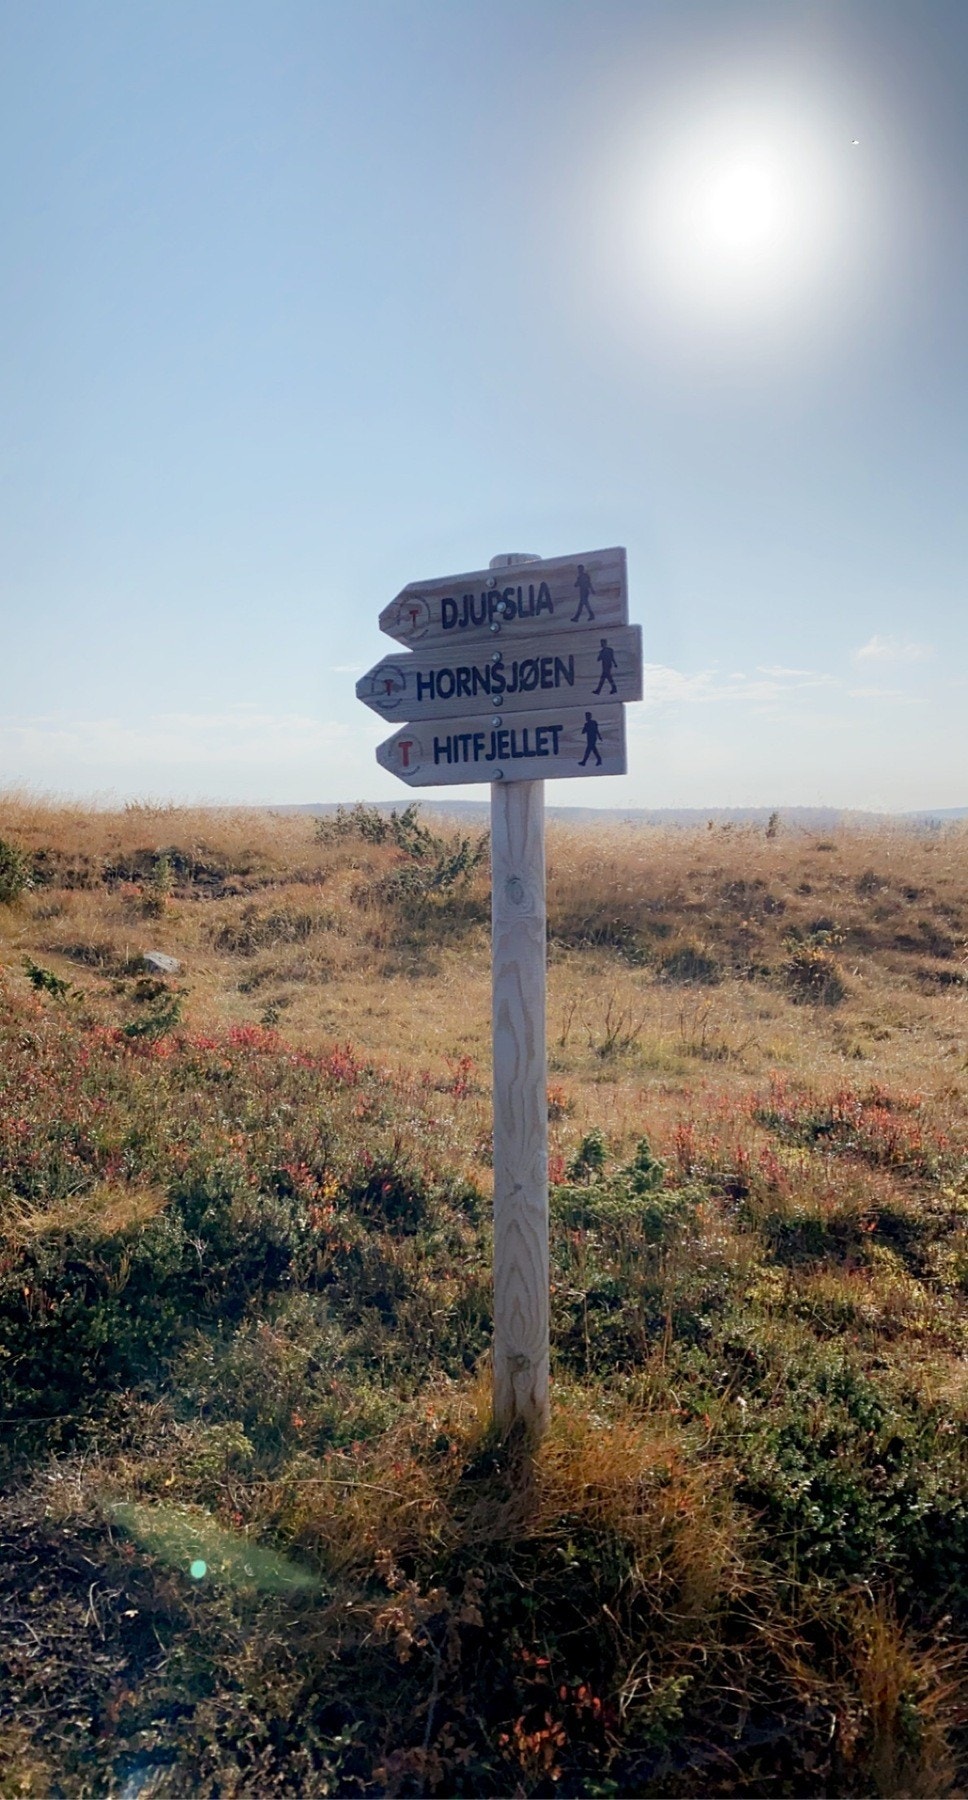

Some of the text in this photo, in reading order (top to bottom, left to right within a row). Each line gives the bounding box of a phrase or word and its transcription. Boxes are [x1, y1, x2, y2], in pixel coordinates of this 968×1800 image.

[441, 582, 554, 629] DJUPSLIA
[416, 654, 575, 702] HORNSJØEN
[398, 725, 563, 767] T HITFJELLET
